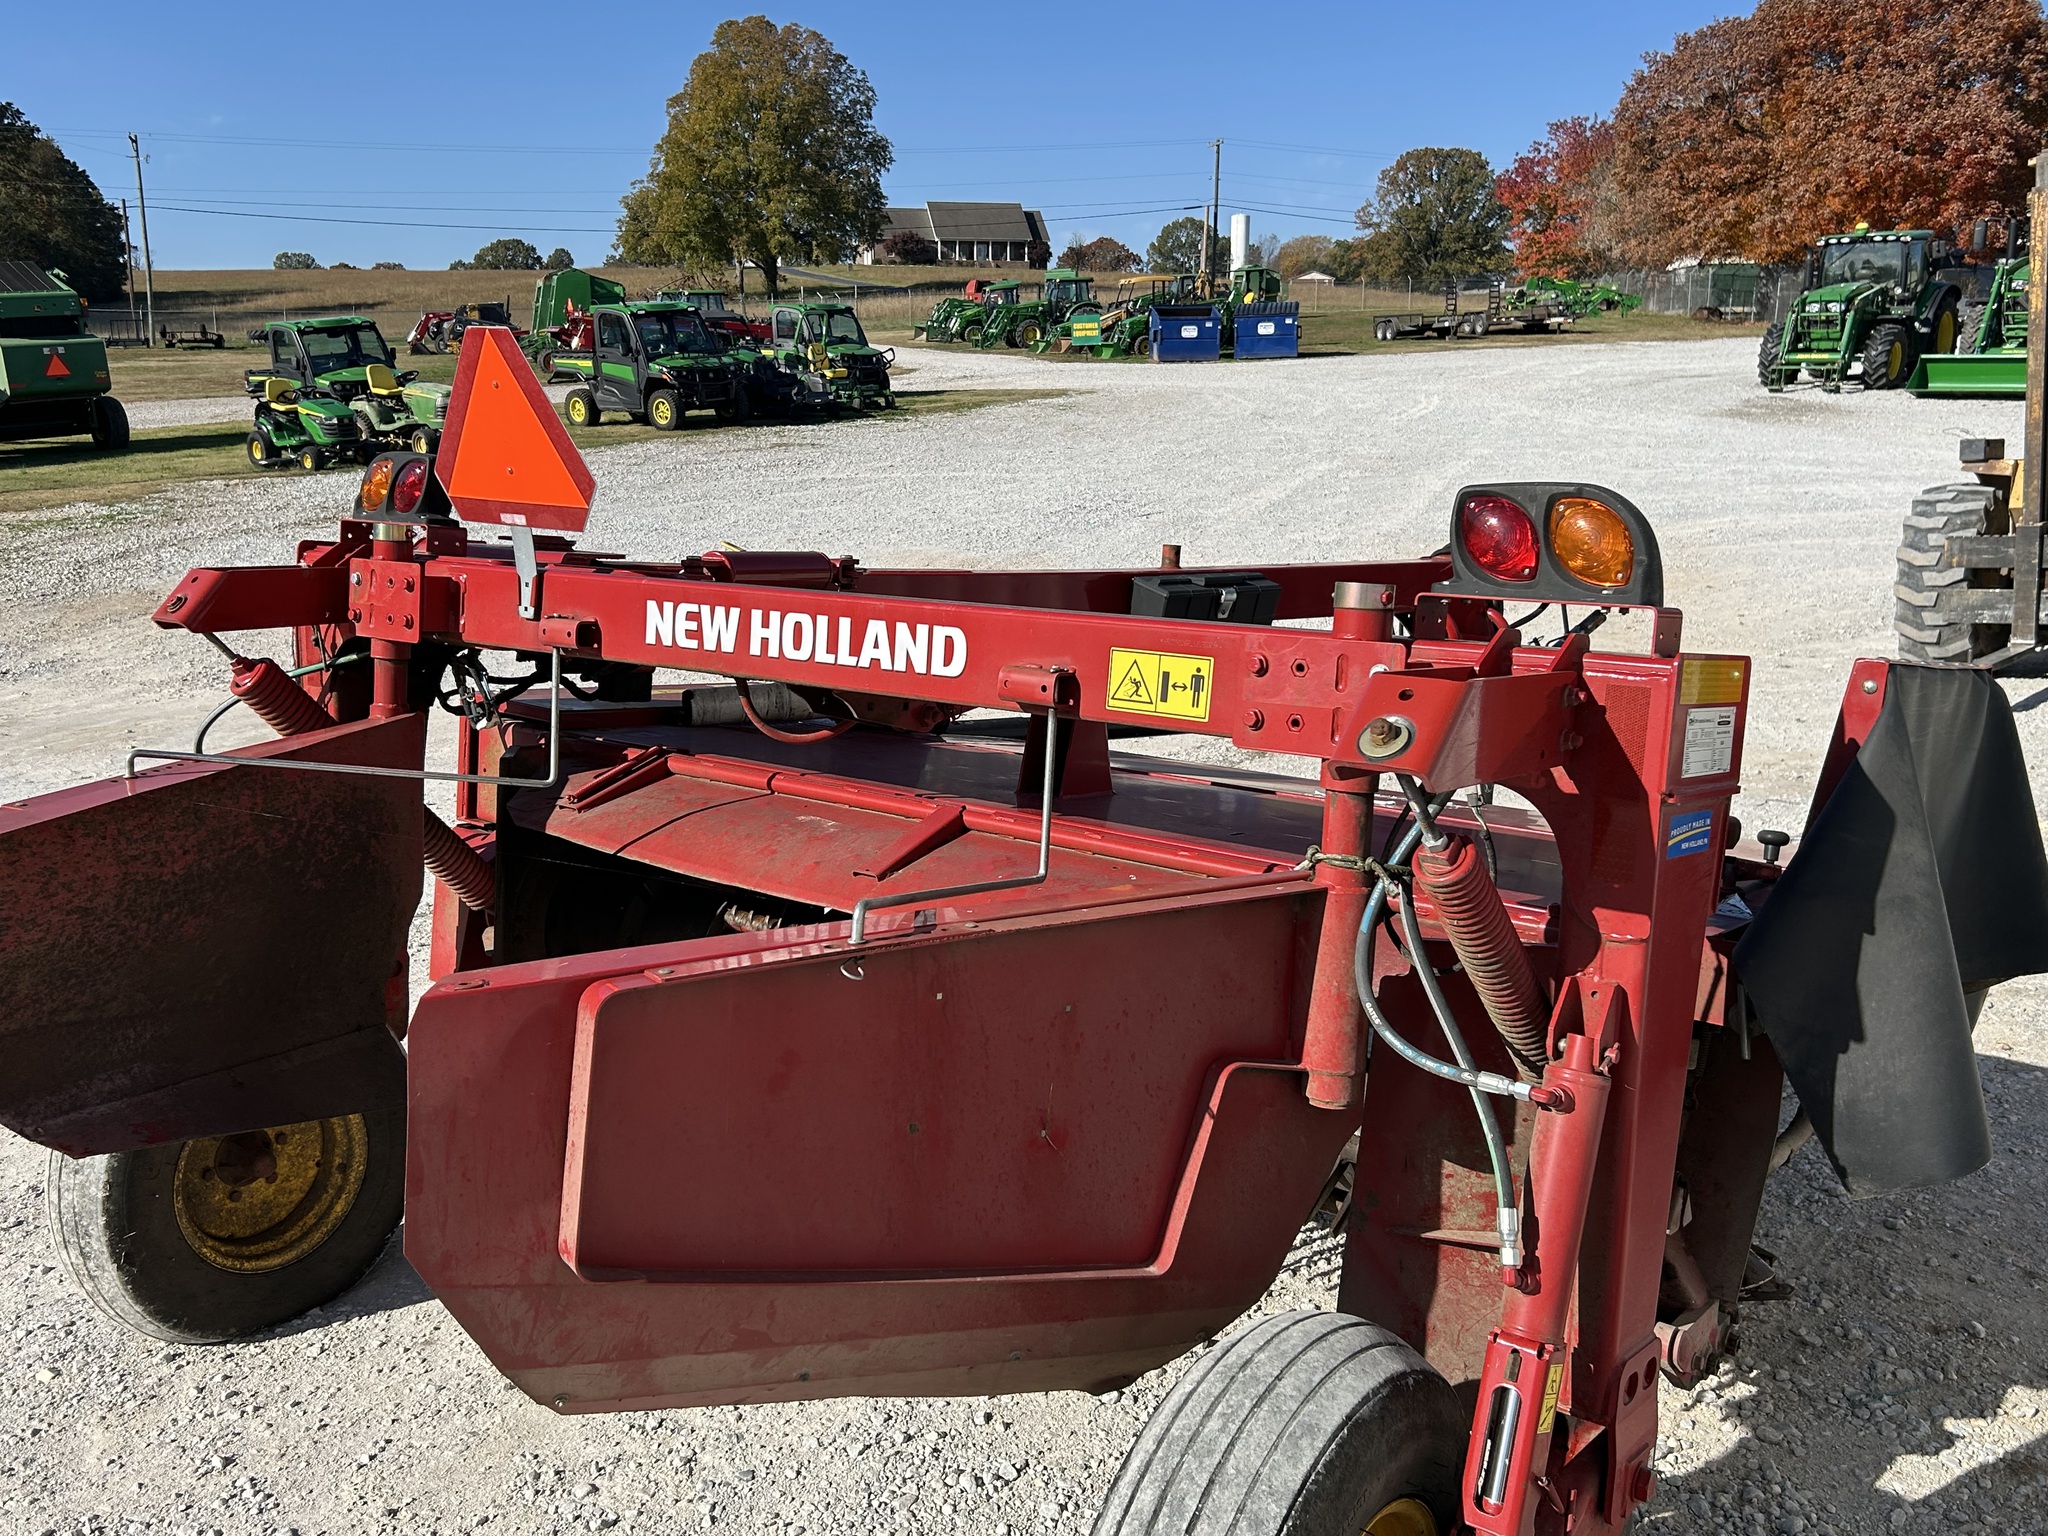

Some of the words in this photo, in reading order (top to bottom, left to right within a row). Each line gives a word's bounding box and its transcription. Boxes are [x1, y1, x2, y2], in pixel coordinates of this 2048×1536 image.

[645, 600, 740, 653] NEW
[749, 609, 968, 679] HOLLAND
[1670, 822, 1692, 838] PROUDLY
[1692, 818, 1704, 829] MADE
[1681, 841, 1689, 850] NEW
[1365, 1002, 1382, 1025] GATES
